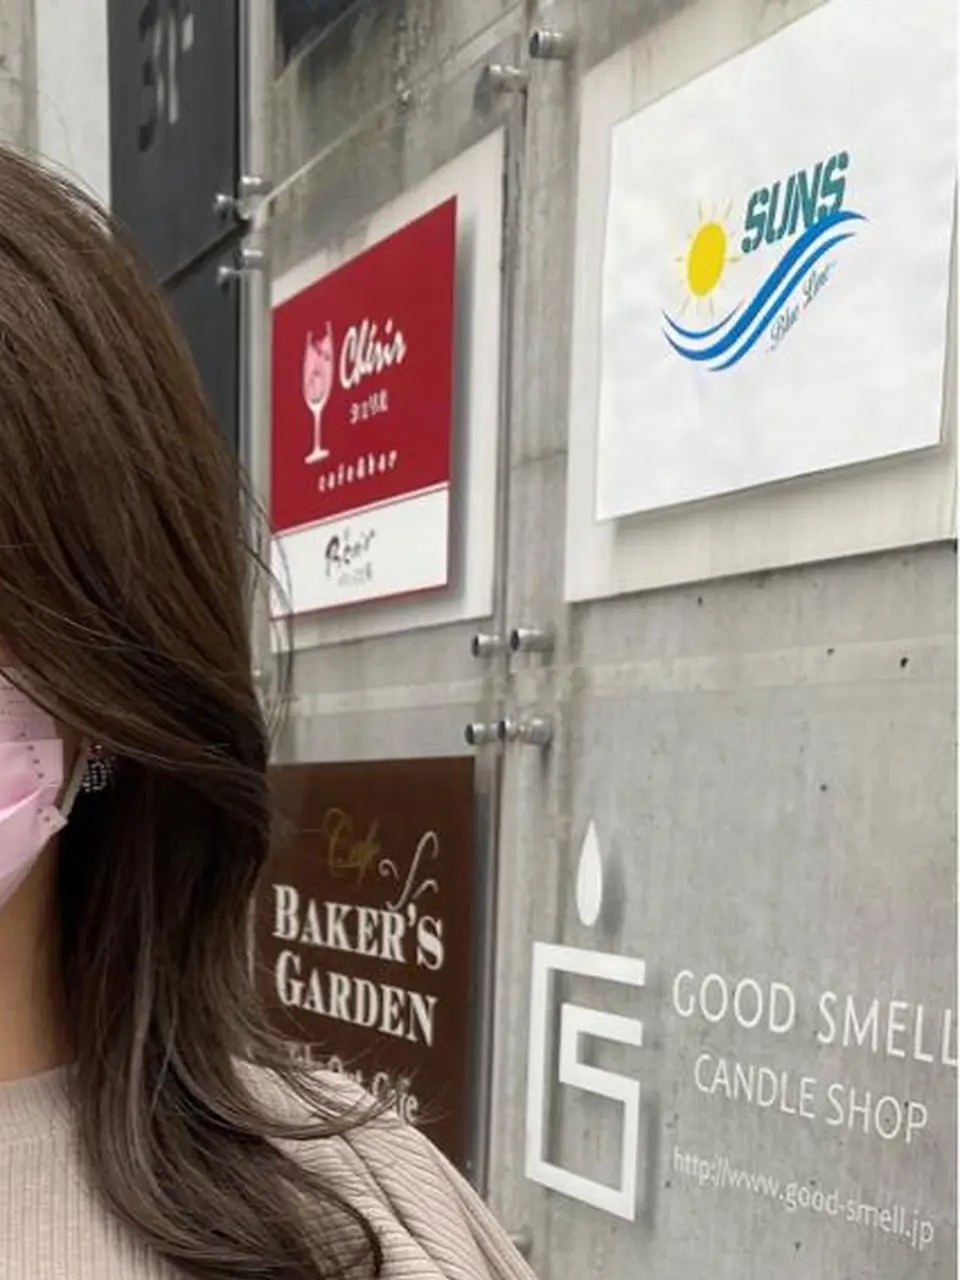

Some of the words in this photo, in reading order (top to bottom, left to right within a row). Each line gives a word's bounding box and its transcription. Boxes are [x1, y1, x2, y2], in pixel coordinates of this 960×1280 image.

[741, 151, 850, 254] SUNS
[272, 883, 445, 971] BAKER'S
[275, 949, 440, 1048] GARDEN
[672, 969, 796, 1034] GOOD
[817, 991, 958, 1066] SMELL
[694, 1053, 817, 1119] CANDLE
[826, 1083, 929, 1144] SHOP
[673, 1144, 935, 1251] http://www.good-smell.jp
